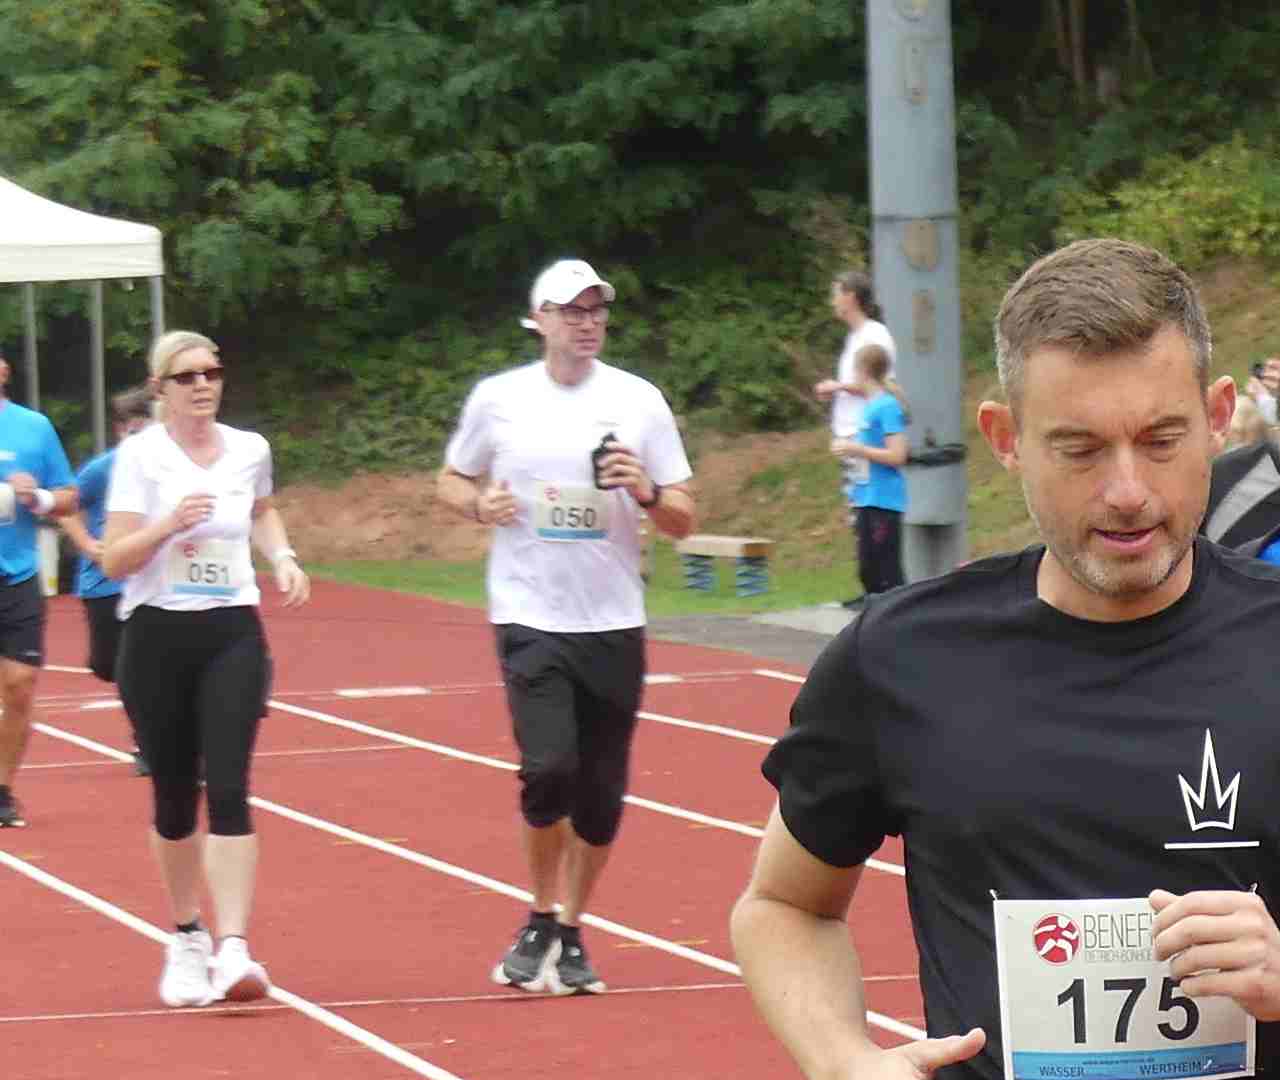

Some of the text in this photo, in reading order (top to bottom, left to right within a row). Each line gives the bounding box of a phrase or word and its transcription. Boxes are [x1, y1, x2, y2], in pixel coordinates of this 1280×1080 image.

[552, 506, 597, 528] 050
[189, 563, 229, 584] 051
[1057, 977, 1200, 1044] 175
[1039, 1065, 1086, 1078] WASSER
[1139, 1061, 1202, 1076] WERTHEIM
